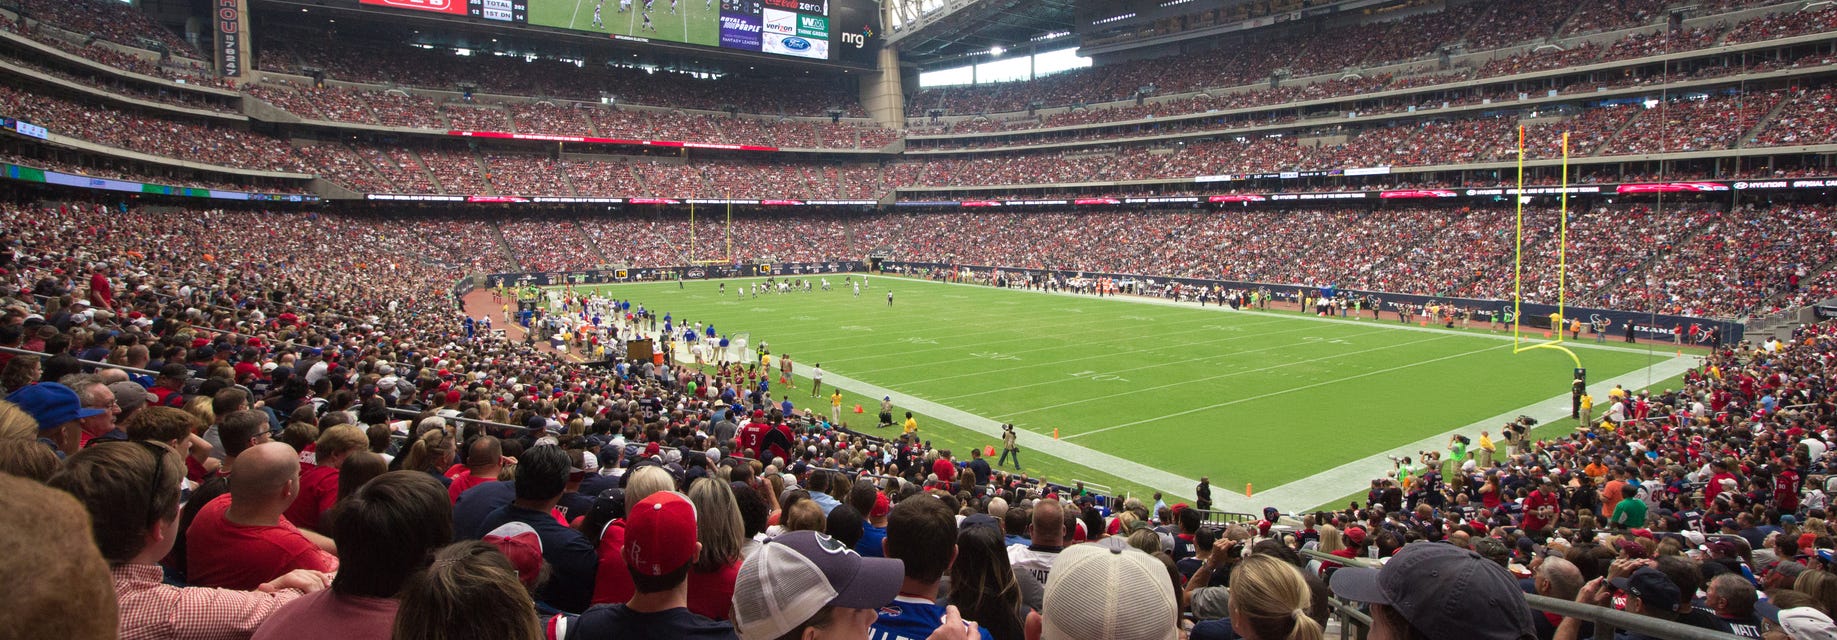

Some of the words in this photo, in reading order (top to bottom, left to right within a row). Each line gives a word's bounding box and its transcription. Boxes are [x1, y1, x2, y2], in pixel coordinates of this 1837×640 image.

[720, 16, 741, 24] ROYAL
[801, 16, 825, 31] WM
[734, 22, 762, 33] PURPLE
[766, 23, 793, 32] verizon
[841, 31, 864, 49] nrg
[1623, 323, 1676, 335] EXANS
[750, 434, 756, 446] 3
[1030, 568, 1050, 585] WAT
[1729, 622, 1761, 638] WATT
